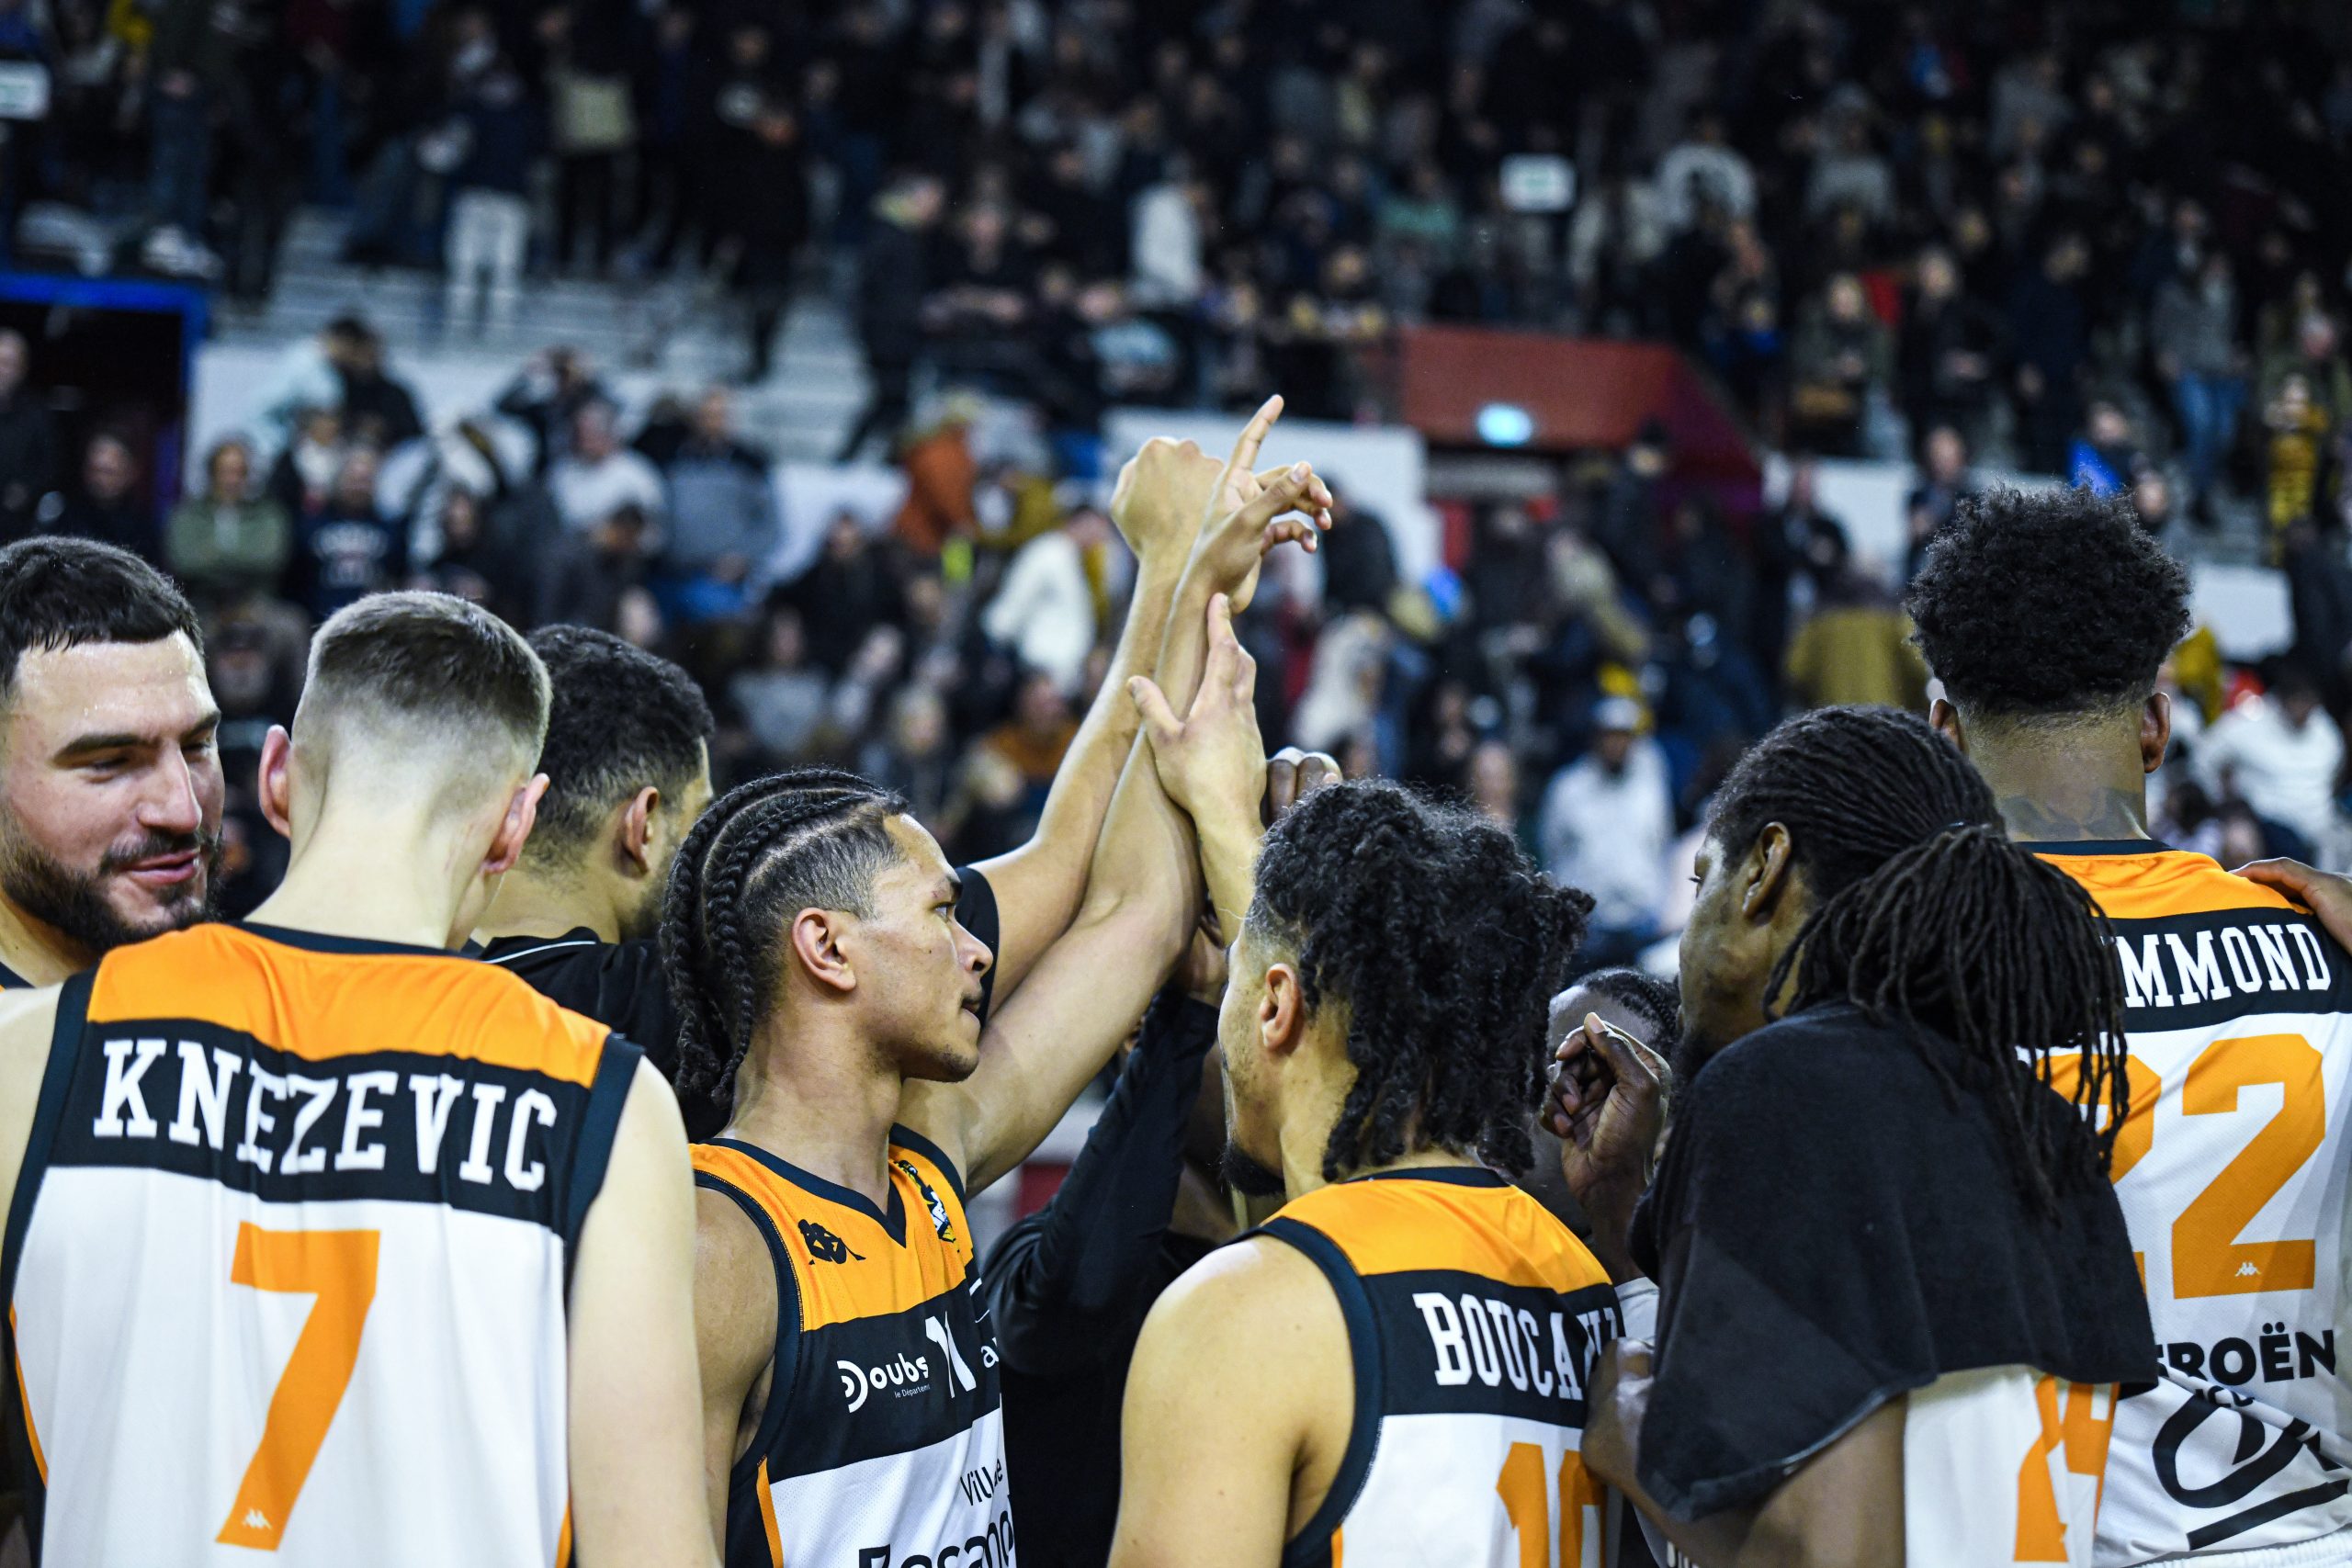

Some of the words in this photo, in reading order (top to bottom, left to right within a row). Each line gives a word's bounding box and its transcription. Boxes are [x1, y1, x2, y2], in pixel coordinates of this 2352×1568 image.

[2113, 923, 2332, 1008] MMOND
[93, 1039, 557, 1192] KNEZEVIC
[215, 1221, 380, 1552] 7
[836, 1352, 929, 1414] Doubs
[2154, 1321, 2336, 1386] ROËN
